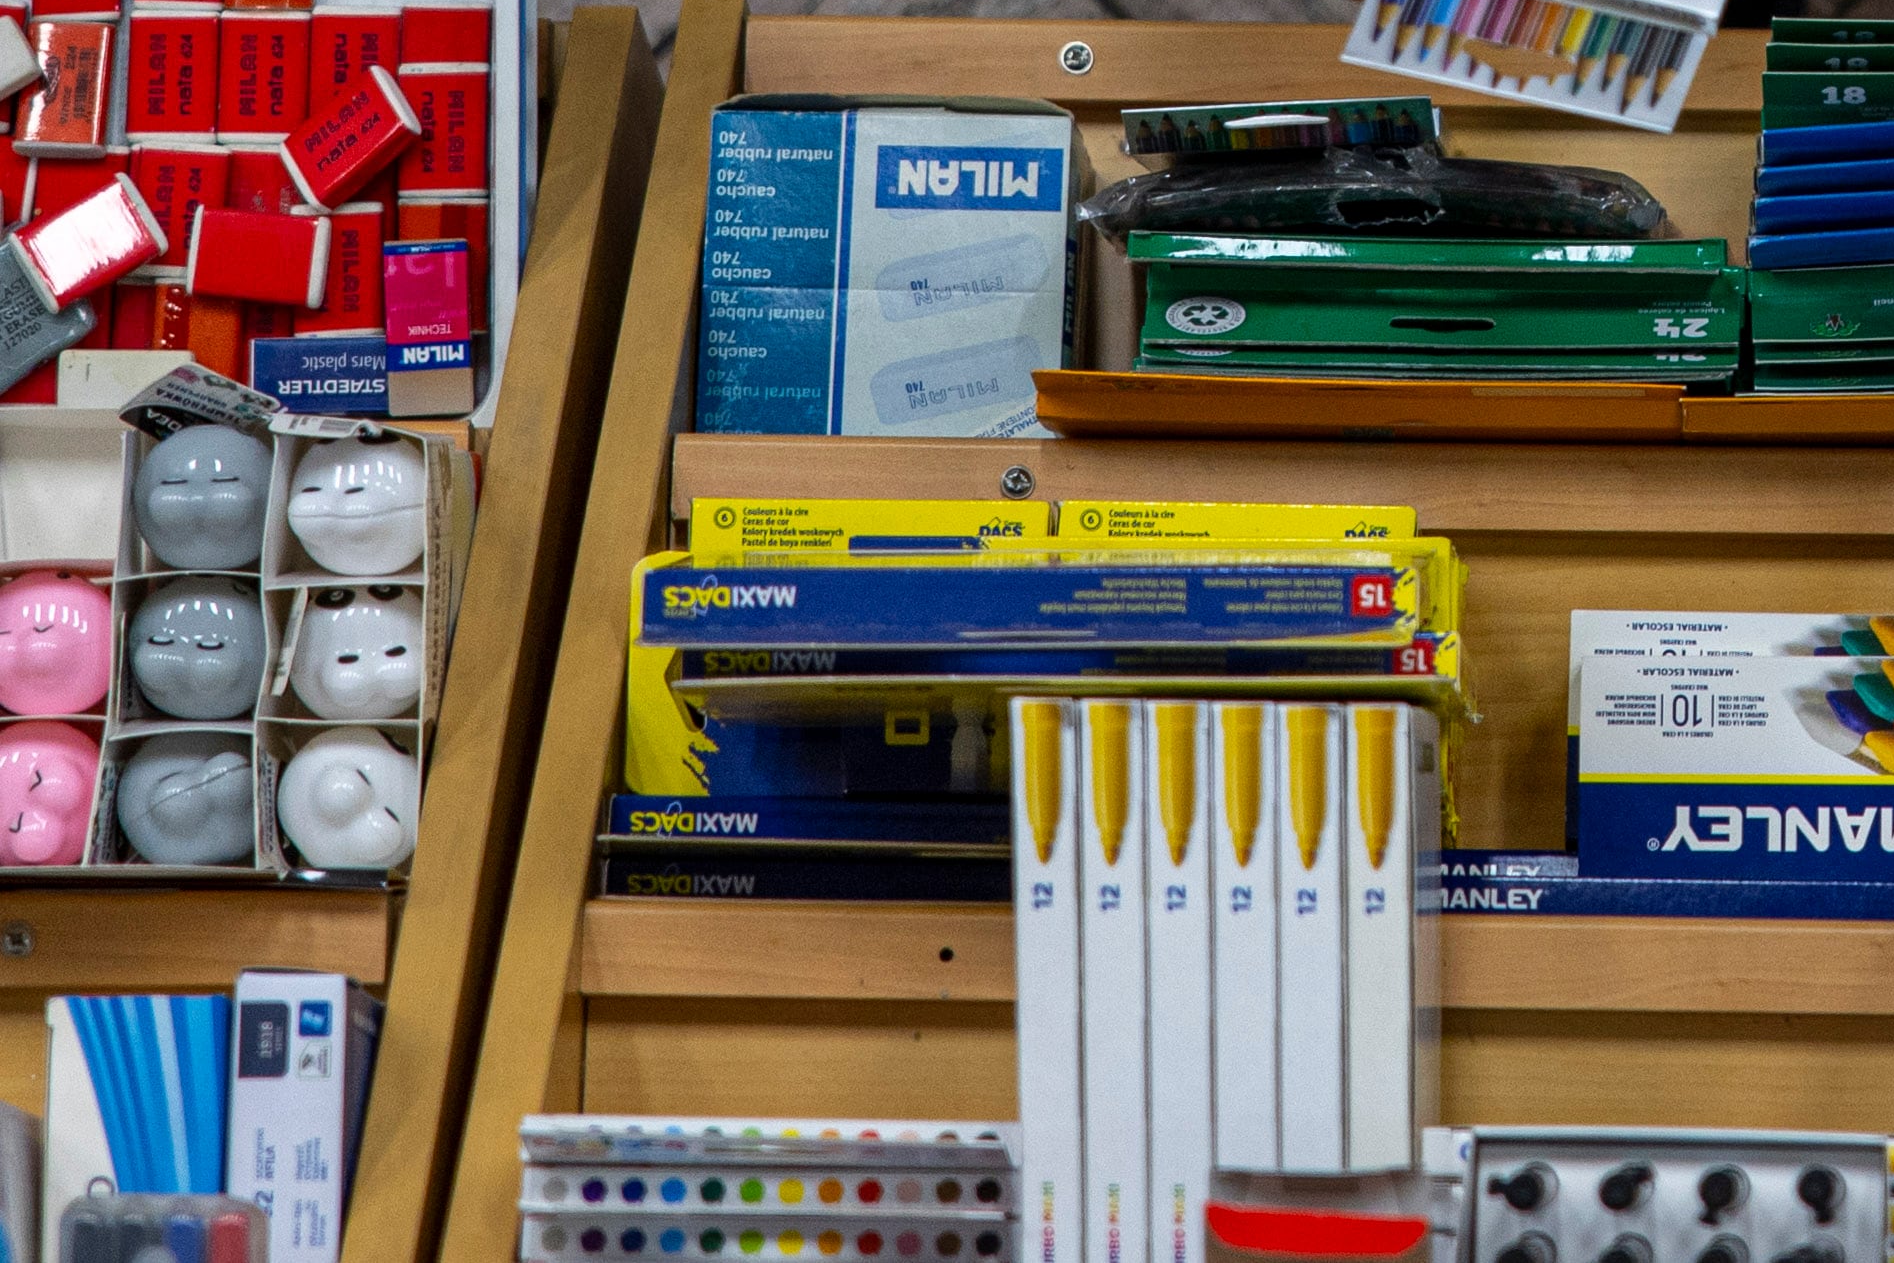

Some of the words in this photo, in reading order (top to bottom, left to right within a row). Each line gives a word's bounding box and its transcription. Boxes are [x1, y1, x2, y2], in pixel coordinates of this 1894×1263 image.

[180, 34, 193, 60] 624
[271, 35, 284, 59] 624
[335, 34, 348, 84] nata
[148, 34, 166, 115] MILAN
[240, 34, 258, 116] MILAN
[177, 65, 193, 115] nata
[269, 66, 284, 116] nata
[1821, 86, 1867, 105] 18
[305, 91, 371, 153] MILAN
[422, 91, 436, 143] nata
[448, 91, 465, 173] MILAN
[719, 129, 748, 145] 740
[316, 133, 359, 171] nata
[361, 112, 382, 134] 624
[718, 146, 773, 159] rubber
[776, 147, 834, 161] natural
[188, 168, 201, 193] 624
[717, 168, 746, 183] 740
[897, 158, 1039, 198] MILAN
[715, 184, 776, 198] caucho
[714, 208, 744, 223] 740
[713, 224, 768, 238] rubber
[771, 224, 830, 239] natural
[712, 250, 741, 265] 740
[341, 229, 360, 313] MILAN
[711, 266, 772, 280] caucho
[710, 290, 739, 304] 740
[914, 275, 1005, 307] MILAN
[708, 305, 764, 319] rubber
[768, 305, 826, 321] natural
[407, 323, 452, 337] TECHNIK
[1652, 317, 1710, 338] 24
[707, 329, 737, 343] 740
[402, 344, 464, 365] MILAN
[707, 345, 768, 359] caucho
[301, 351, 348, 373] plastic
[351, 355, 386, 369] Mars
[706, 368, 737, 383] 740
[277, 378, 386, 394] STAEDTLER
[705, 386, 760, 400] rubber
[764, 385, 822, 399] natural
[905, 380, 924, 394] 740
[908, 377, 1000, 410] MILAN
[704, 411, 733, 425] 740
[742, 506, 777, 518] Couleurs
[786, 506, 793, 517] la
[795, 506, 809, 517] cire
[1108, 509, 1143, 520] Couleurs
[1160, 509, 1175, 520] cire
[742, 516, 765, 527] Ceras
[766, 516, 776, 526] de
[1108, 519, 1129, 529] Ceras
[1131, 519, 1143, 529] de
[741, 526, 768, 538] Kolory
[769, 526, 797, 537] kredek
[798, 526, 845, 538] woskowych
[978, 525, 1024, 538] DACS
[741, 538, 765, 548] Pastel
[767, 538, 777, 548] de
[779, 538, 798, 550] boya
[663, 585, 797, 610] MAXIDACS
[1358, 583, 1388, 608] 15
[1631, 622, 1674, 631] ESCOLAR
[1676, 623, 1722, 632] MATERIAL
[703, 651, 837, 674] MAXIDACS
[1400, 648, 1426, 675] 15
[1642, 667, 1686, 676] ESCOLAR
[1687, 667, 1733, 677] MATERIAL
[1671, 694, 1703, 727] 10
[629, 811, 759, 834] MAXIDACS
[627, 874, 755, 895] MAXIDACS
[1031, 882, 1054, 911] 12
[1101, 884, 1121, 911] 12
[1166, 884, 1188, 911] 12
[1232, 884, 1253, 913] 12
[1298, 887, 1320, 915] 12
[1365, 886, 1386, 915] 12
